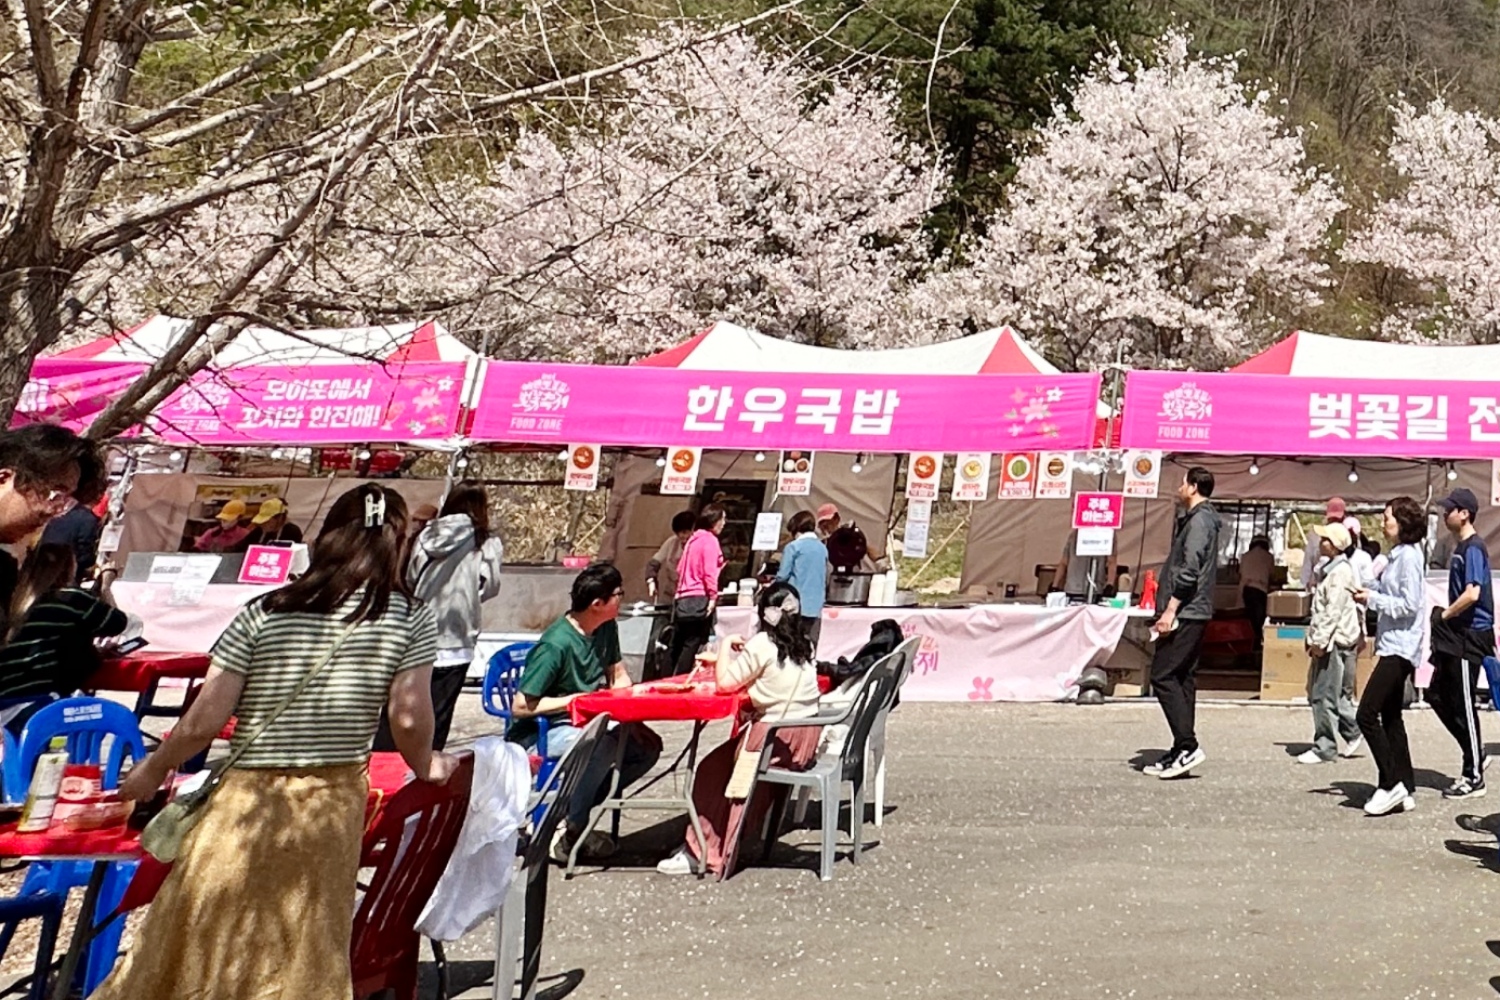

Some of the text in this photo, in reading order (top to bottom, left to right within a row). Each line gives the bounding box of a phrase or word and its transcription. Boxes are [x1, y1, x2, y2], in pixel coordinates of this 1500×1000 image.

[308, 404, 382, 429] 한잔해!
[683, 385, 901, 436] 한우국밥
[1308, 392, 1448, 441] 벚꽃길
[510, 416, 563, 431] FOOD ZONE
[1158, 425, 1210, 439] FOOD ZONE
